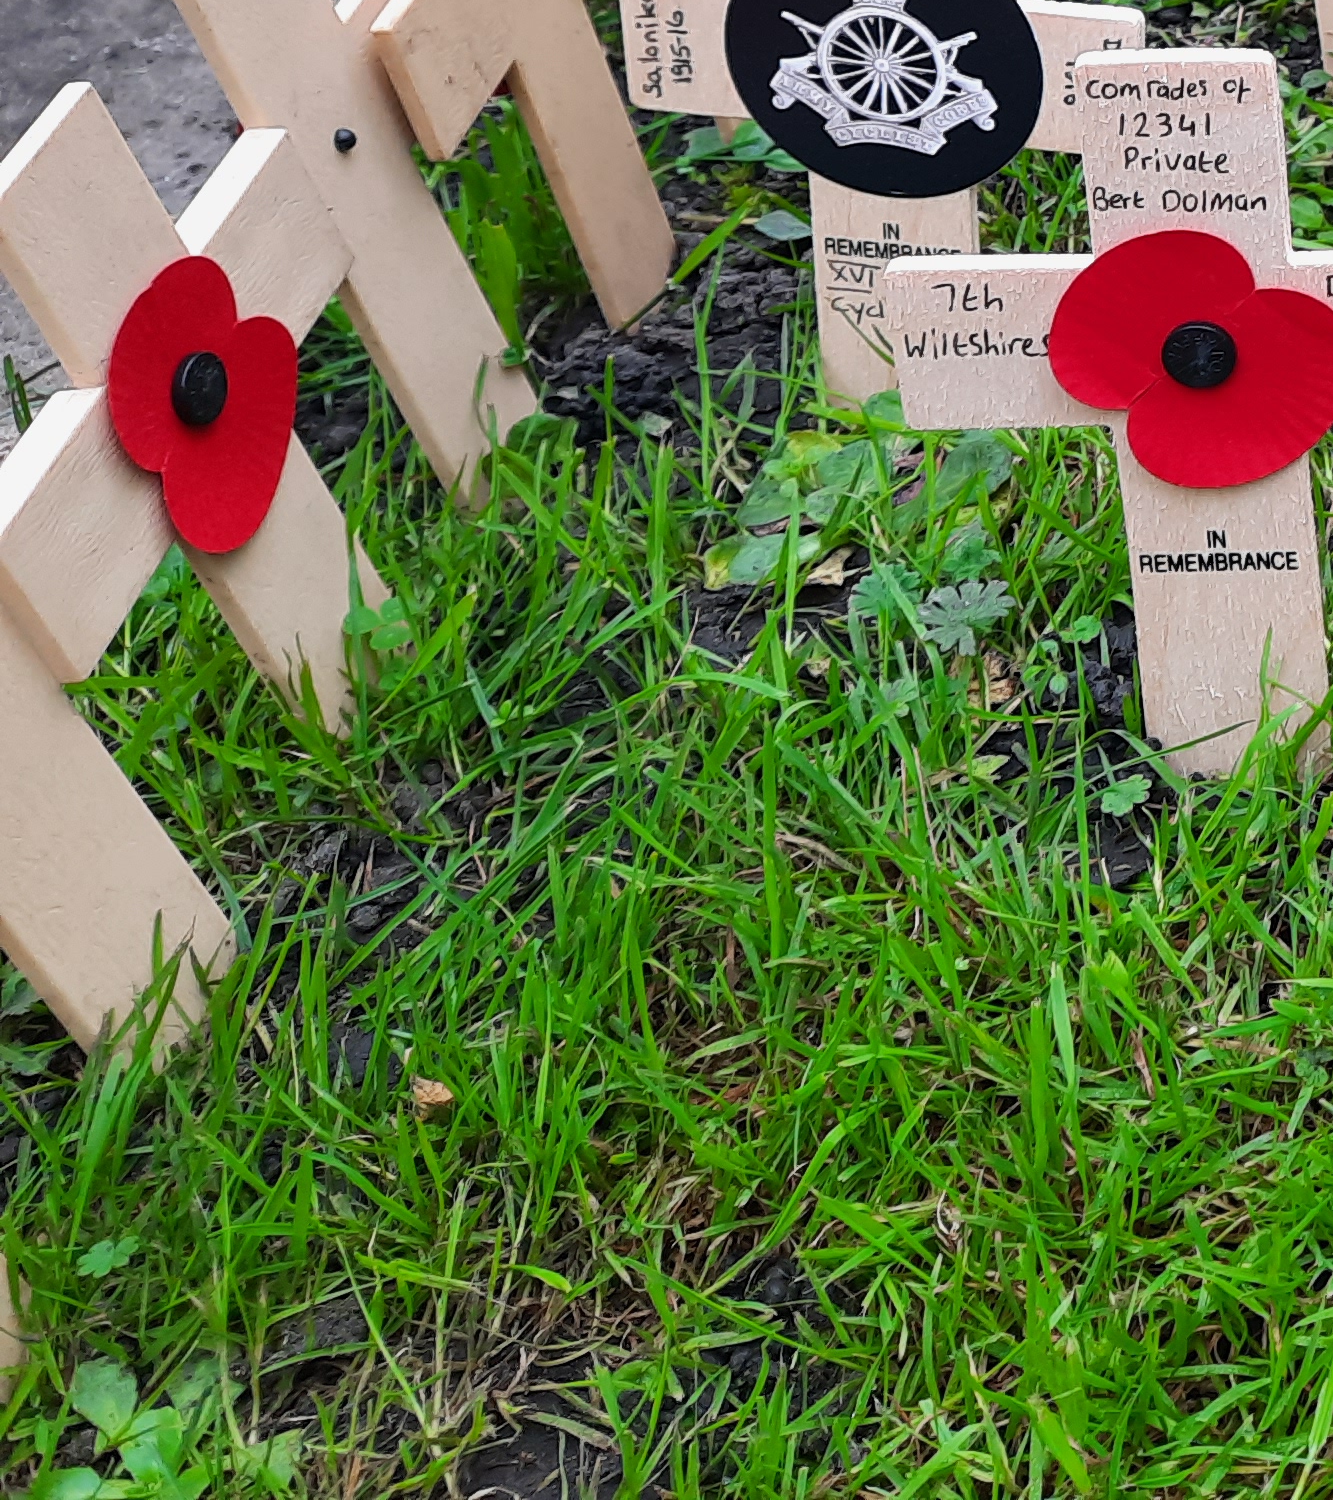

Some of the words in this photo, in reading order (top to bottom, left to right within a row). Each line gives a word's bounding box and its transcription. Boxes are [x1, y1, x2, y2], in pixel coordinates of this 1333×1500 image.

[665, 9, 693, 83] 1915-16
[1085, 77, 1208, 101] Comrades
[1222, 76, 1251, 104] of
[1118, 111, 1212, 138] 12341
[1124, 145, 1230, 174] Private
[1092, 185, 1145, 212] Bert
[1161, 188, 1268, 213] Dolman
[882, 223, 900, 240] IN
[931, 282, 1004, 313] 7th
[904, 328, 1050, 362] Wiltshires
[1206, 530, 1226, 549] IN
[1139, 552, 1299, 573] REMEMBRANCE
